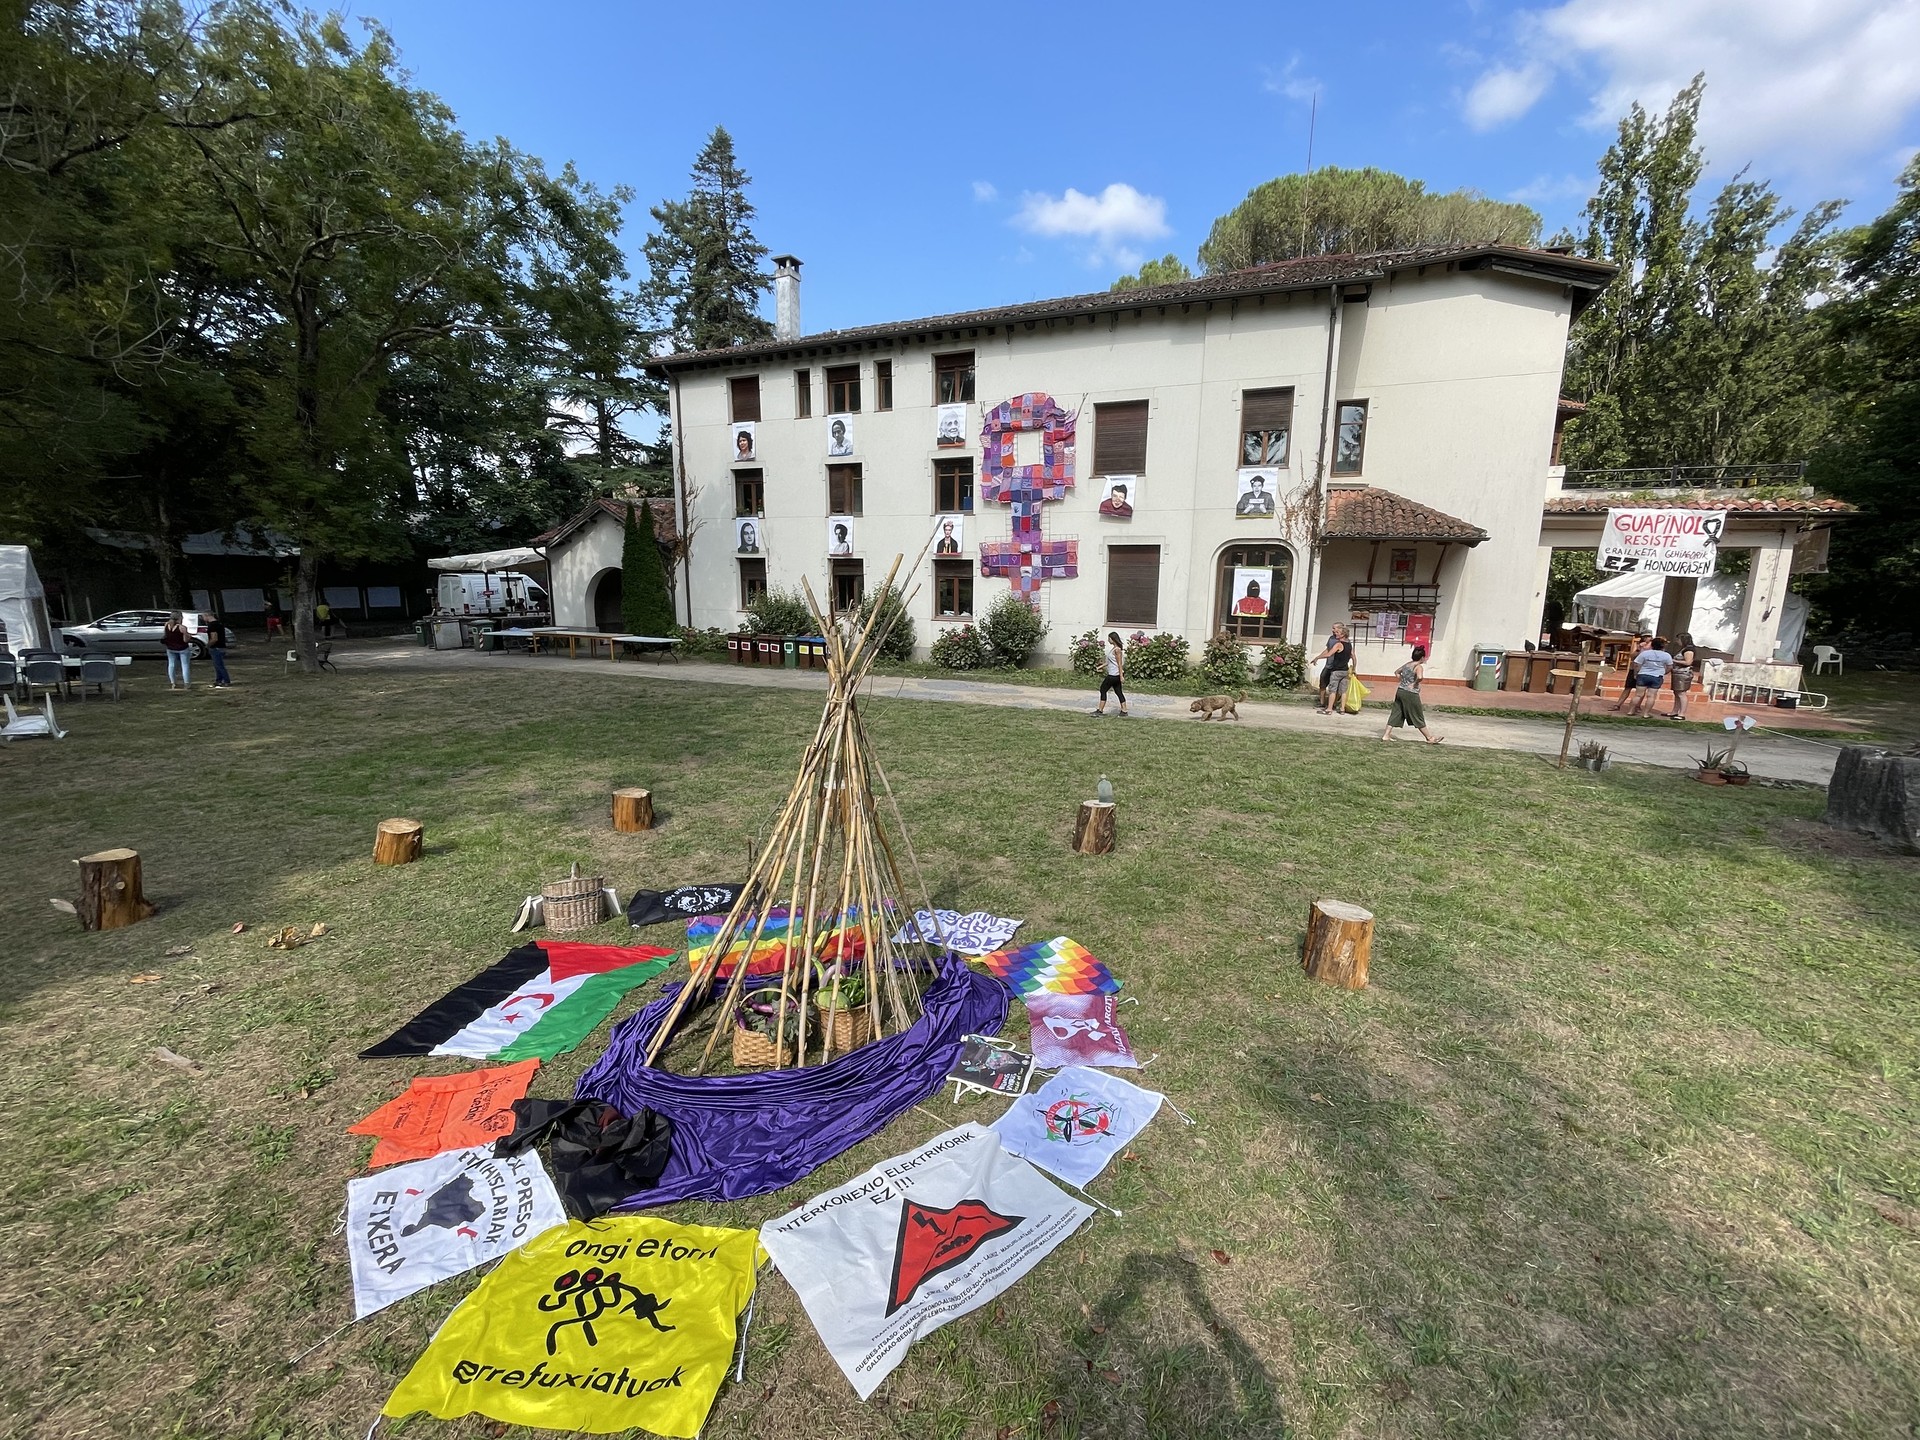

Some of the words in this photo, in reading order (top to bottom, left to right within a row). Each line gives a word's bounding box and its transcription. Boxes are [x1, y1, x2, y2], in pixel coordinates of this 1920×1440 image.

[1624, 535, 1680, 547] RESISTE
[1603, 555, 1639, 572] EZ
[1644, 559, 1711, 575] HONDURASEN
[777, 1176, 884, 1233] INTERKONEXIO
[884, 1131, 975, 1179] ELEKTRIKORIK
[870, 1187, 896, 1205] EZ
[512, 1176, 534, 1239] PRESO
